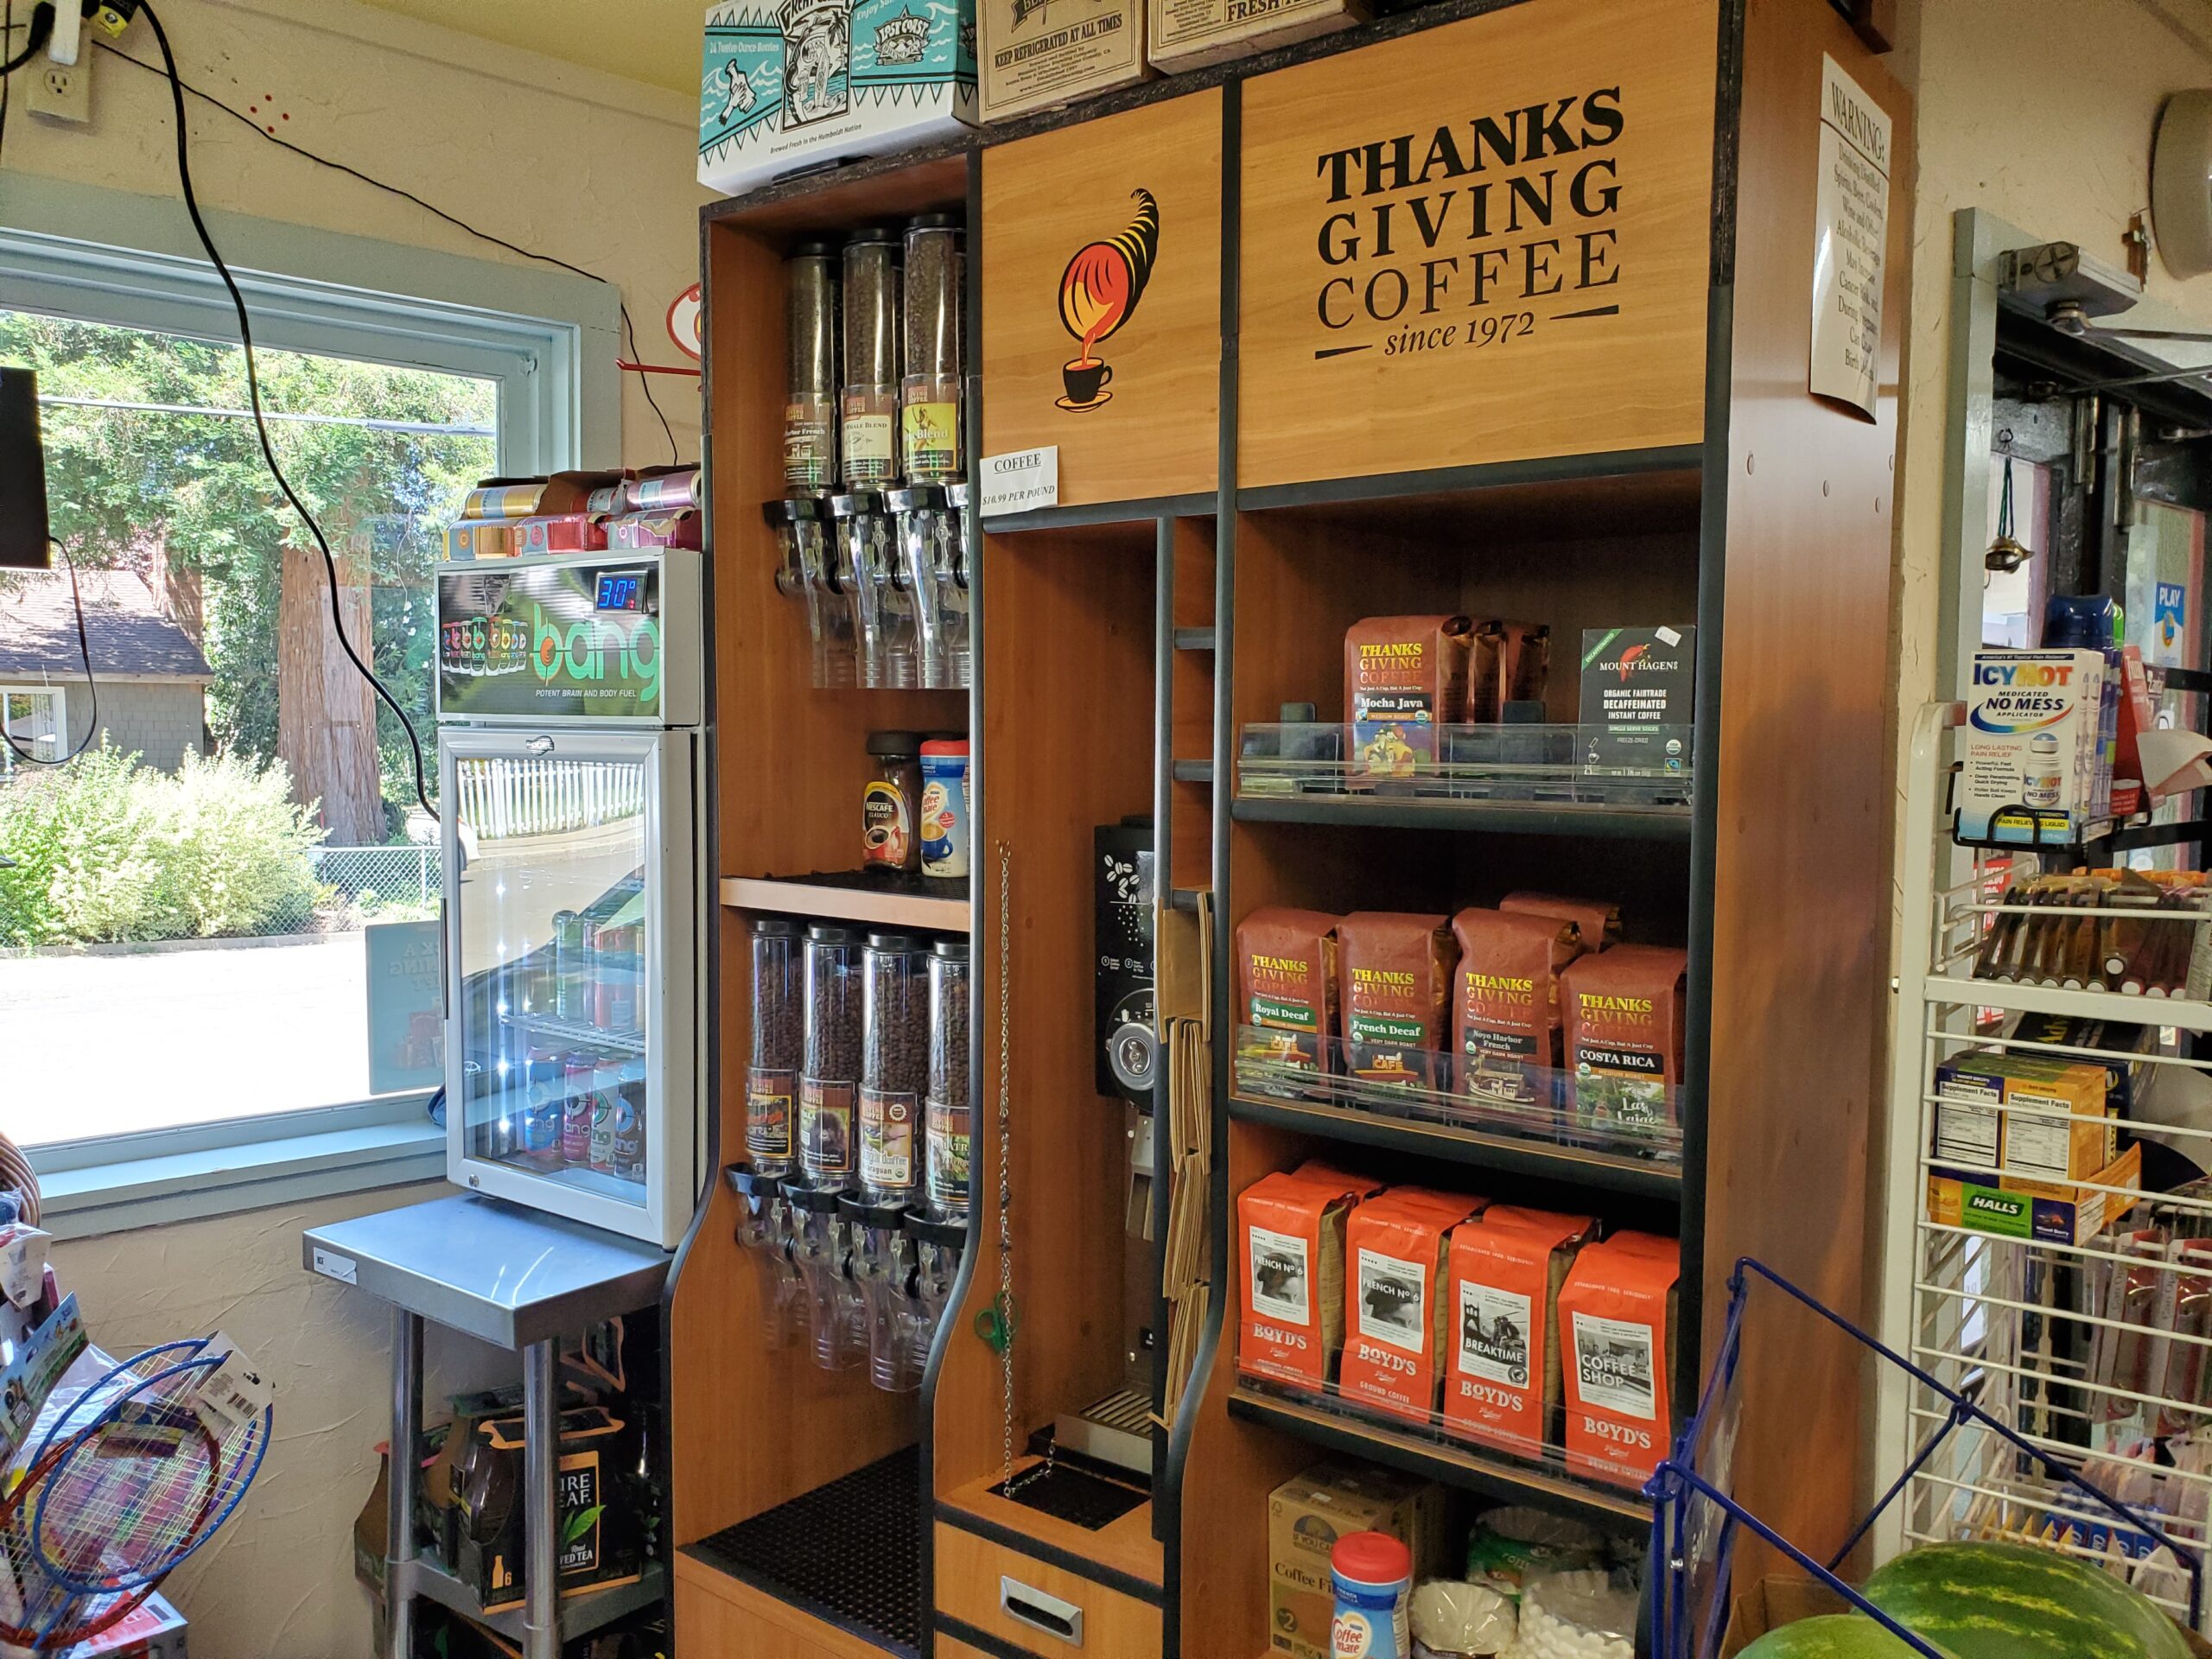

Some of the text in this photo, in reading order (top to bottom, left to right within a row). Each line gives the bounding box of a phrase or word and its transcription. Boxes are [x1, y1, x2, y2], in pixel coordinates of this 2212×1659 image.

[1227, 0, 1280, 22] FRESH
[880, 18, 930, 38] LOST COAST
[718, 41, 779, 54] Twelve Ounce Bottles
[995, 13, 1122, 68] KEEP REFRIGERATED AT ALL TIMES
[1831, 81, 1885, 163] WARNING:
[770, 143, 789, 154] Brewed
[789, 140, 803, 149] Fresh
[818, 130, 844, 140] Humboldt
[844, 124, 862, 133] Nation
[1317, 86, 1624, 204] THANKS
[1317, 157, 1623, 266] GIVING
[1317, 228, 1621, 329] COFFEE
[1840, 270, 1859, 297] Cancer
[1838, 295, 1860, 325] During
[1384, 311, 1535, 356] since 1972
[917, 429, 949, 440] Blend
[994, 454, 1041, 473] COFFEE
[982, 485, 1055, 505] $10.99 PER POUND
[2159, 587, 2181, 608] PLAY
[533, 604, 660, 702] bang
[1359, 643, 1423, 657] THANKS
[1359, 657, 1421, 671] GIVING
[1599, 662, 1636, 671] MOUNT
[1360, 671, 1424, 684] COFFEE
[600, 689, 618, 697] BODY
[620, 689, 637, 697] FUEL
[1361, 697, 1423, 709] Mocha Java
[1603, 700, 1667, 709] DECAFFEINATED
[1986, 698, 2064, 710] NO MESS
[1608, 711, 1636, 720] INSTANT
[1251, 954, 1308, 972] THANKS
[1252, 967, 1308, 984] GIVING
[1351, 968, 1414, 985] THANKS
[1465, 972, 1533, 992] THANKS
[1353, 982, 1414, 997] GIVING
[1466, 986, 1533, 1006] GIVING
[1255, 1002, 1309, 1020] Royal Decaf
[1580, 994, 1652, 1013] THANKS
[1580, 1008, 1653, 1027] GIVING
[1353, 1020, 1421, 1037] French Decaf
[1473, 1029, 1523, 1044] Noyo Harbor
[1484, 1039, 1510, 1051] French
[1373, 1059, 1403, 1071] CAFE
[1580, 1049, 1656, 1068] COSTA RICA
[1599, 1069, 1624, 1077] MEDIUM
[1942, 1083, 1997, 1098] Supplement Facts
[1623, 1096, 1648, 1111] Las
[2010, 1093, 2070, 1109] Supplement Facts
[1973, 1197, 2018, 1215] HALLS
[2054, 1228, 2069, 1236] Berry
[1254, 1255, 1282, 1270] FRENCH
[1297, 1266, 1303, 1275] 6
[1363, 1277, 1395, 1296] FRENCH
[1413, 1292, 1419, 1302] 6
[1254, 1323, 1307, 1350] BOYD'S
[1358, 1344, 1417, 1376] BOYD'S
[1465, 1338, 1523, 1363] BREAKTIME
[1581, 1353, 1637, 1376] COFFEE
[1582, 1368, 1624, 1389] SHOP
[1360, 1381, 1410, 1404] GROUND COFFEE
[1459, 1381, 1523, 1412] BOYD'S
[1584, 1416, 1651, 1450] BOYD'S
[1301, 1535, 1319, 1548] YOU
[577, 1550, 593, 1562] TEA
[505, 1572, 512, 1586] 6
[1274, 1562, 1315, 1587] Coffee
[1284, 1612, 1294, 1630] 2
[1332, 1618, 1363, 1643] Coffee
[1336, 1641, 1360, 1654] mate
